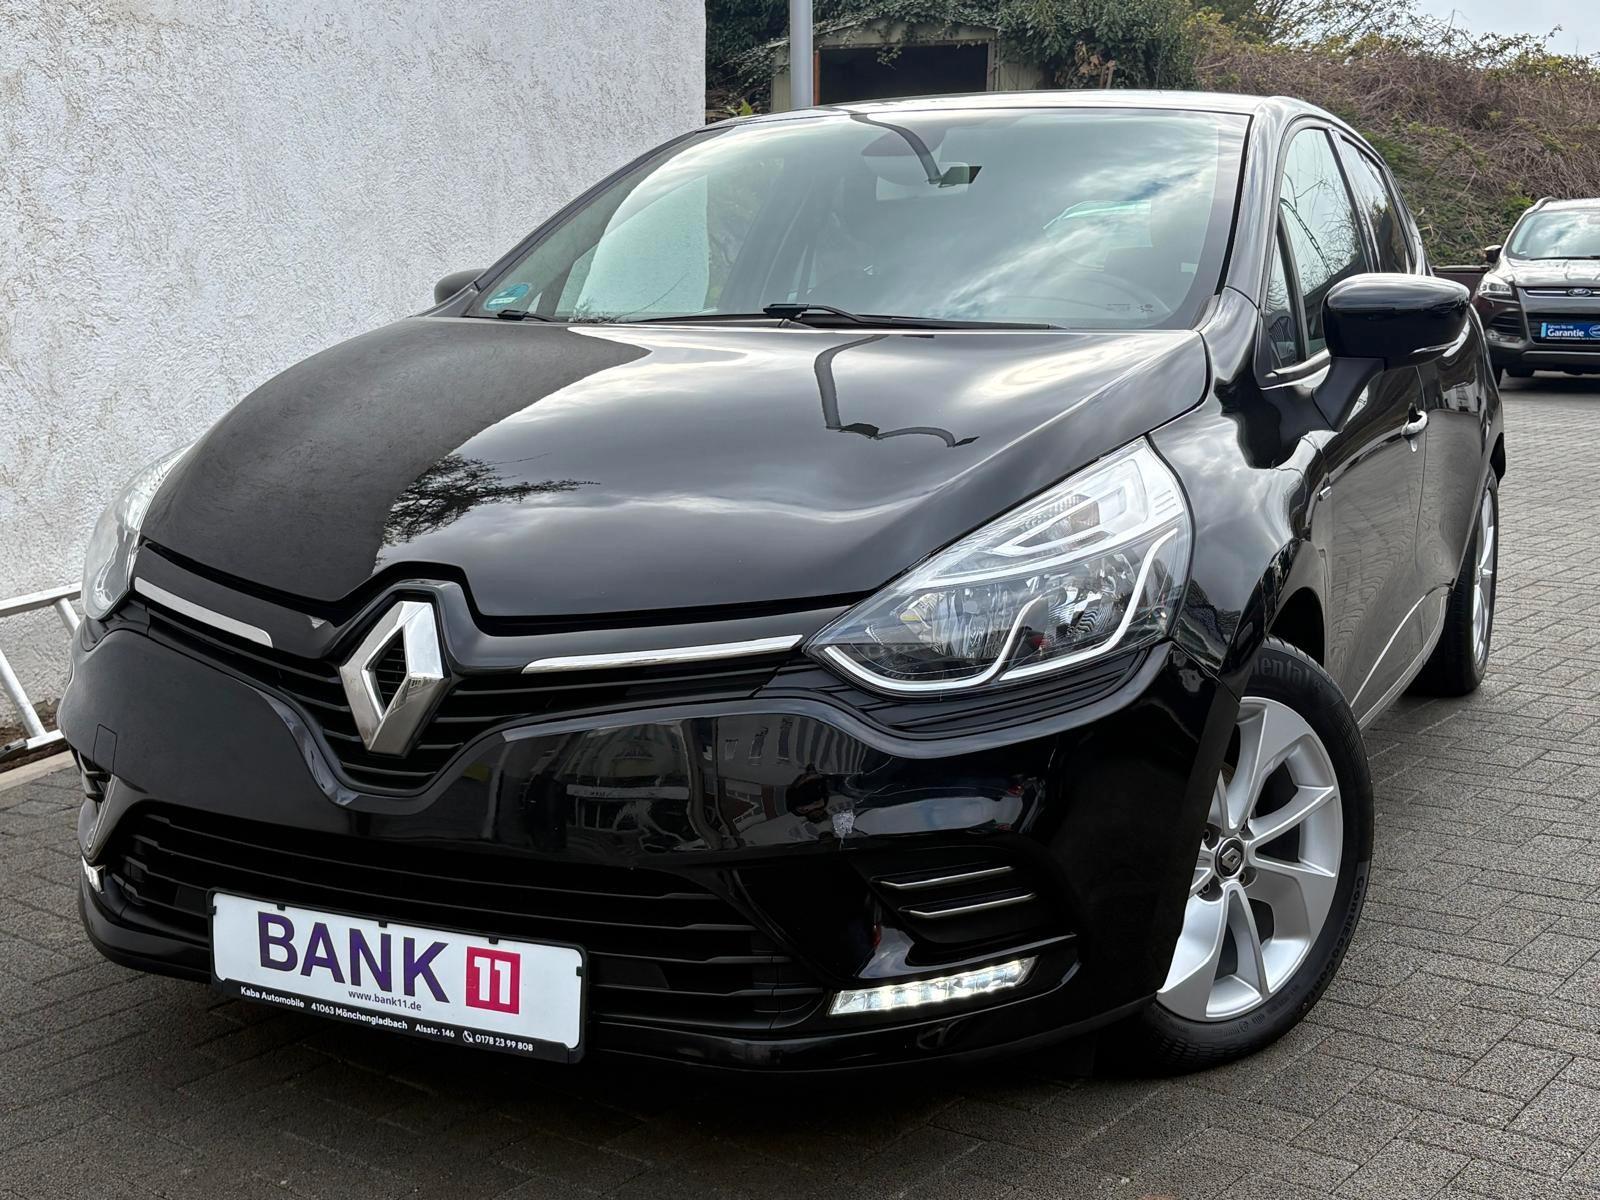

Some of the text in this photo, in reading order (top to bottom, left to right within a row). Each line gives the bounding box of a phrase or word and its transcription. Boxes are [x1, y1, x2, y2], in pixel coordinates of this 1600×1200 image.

[1547, 328, 1585, 337] Garantie
[258, 911, 512, 1006] BANK 11
[240, 986, 534, 1052] Kaba Automobile 41063 Mönchengladbach Alsstr. 146 0178 23 99 808
[348, 990, 422, 1012] www.bank11.de
